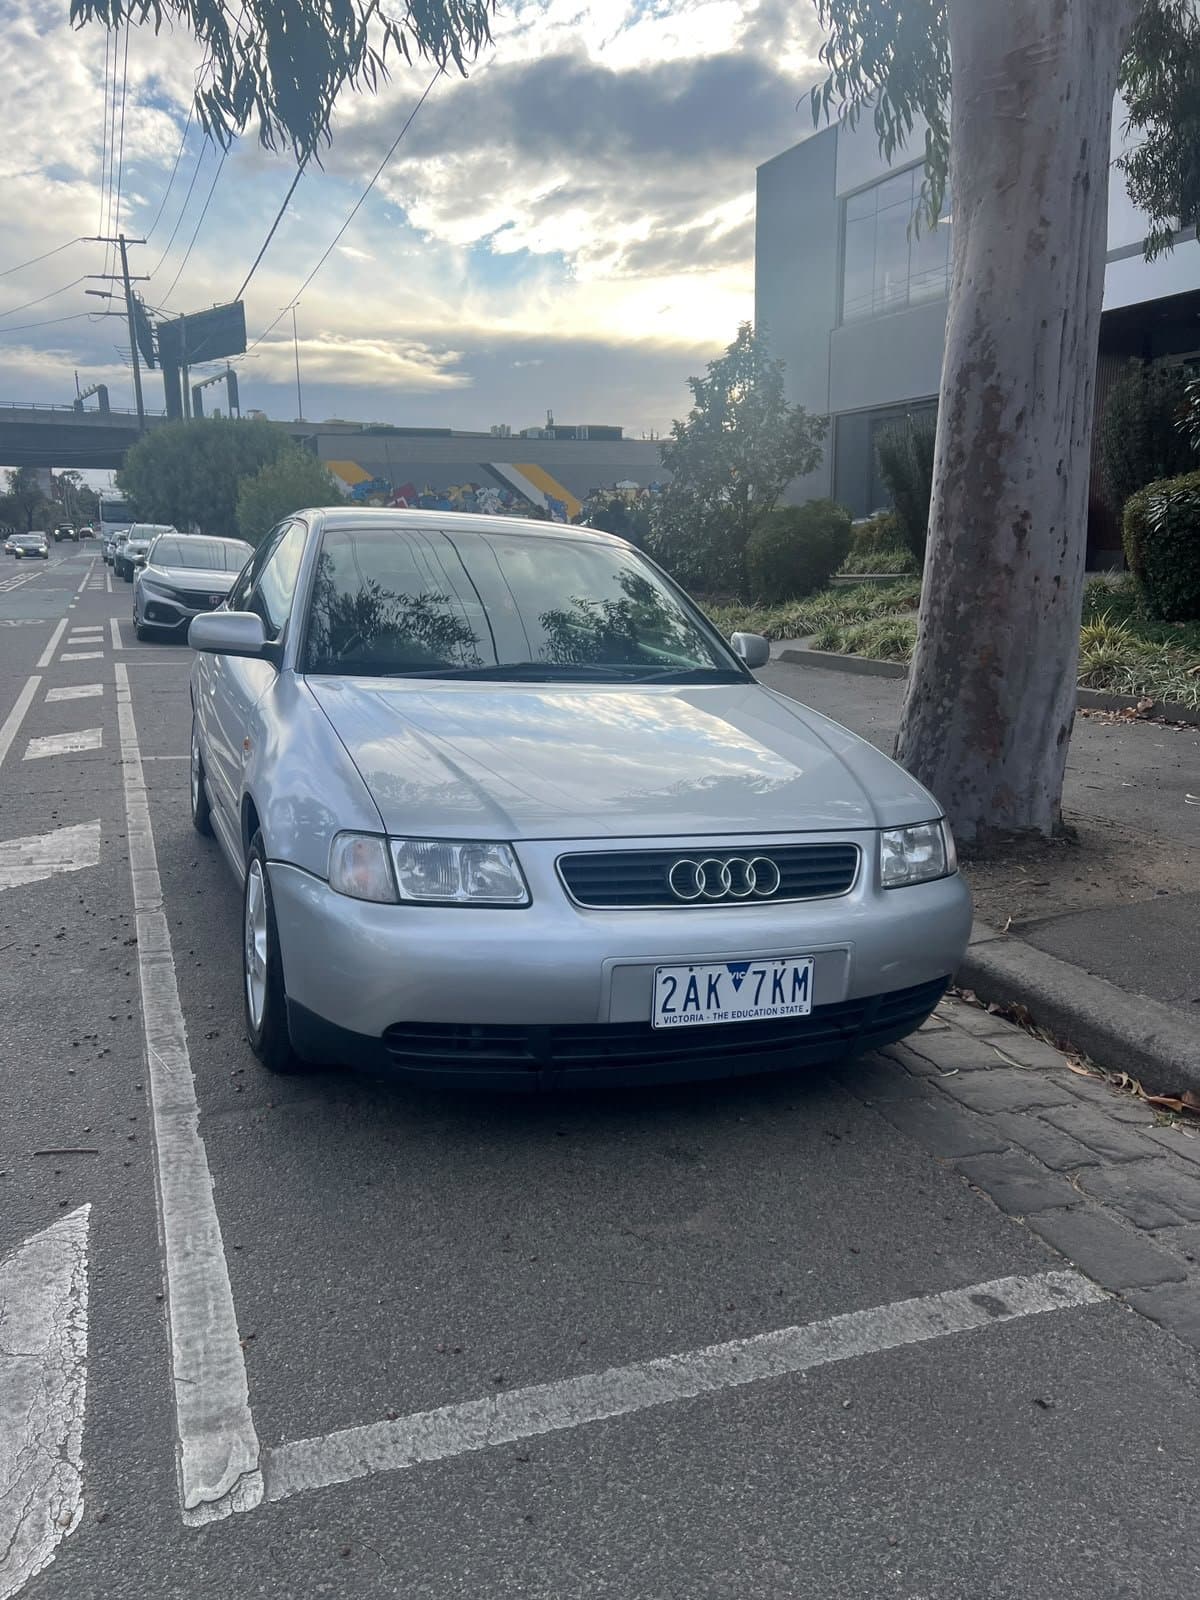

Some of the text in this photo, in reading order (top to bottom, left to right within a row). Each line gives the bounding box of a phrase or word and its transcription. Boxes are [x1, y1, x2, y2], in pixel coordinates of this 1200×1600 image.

[730, 970, 746, 980] VIC
[661, 966, 809, 1014] 2AK 7KM
[663, 1013, 704, 1024] VICTORIA
[713, 1011, 729, 1020] THE
[731, 1007, 778, 1019] EDUCATION
[779, 1005, 804, 1015] STATE
